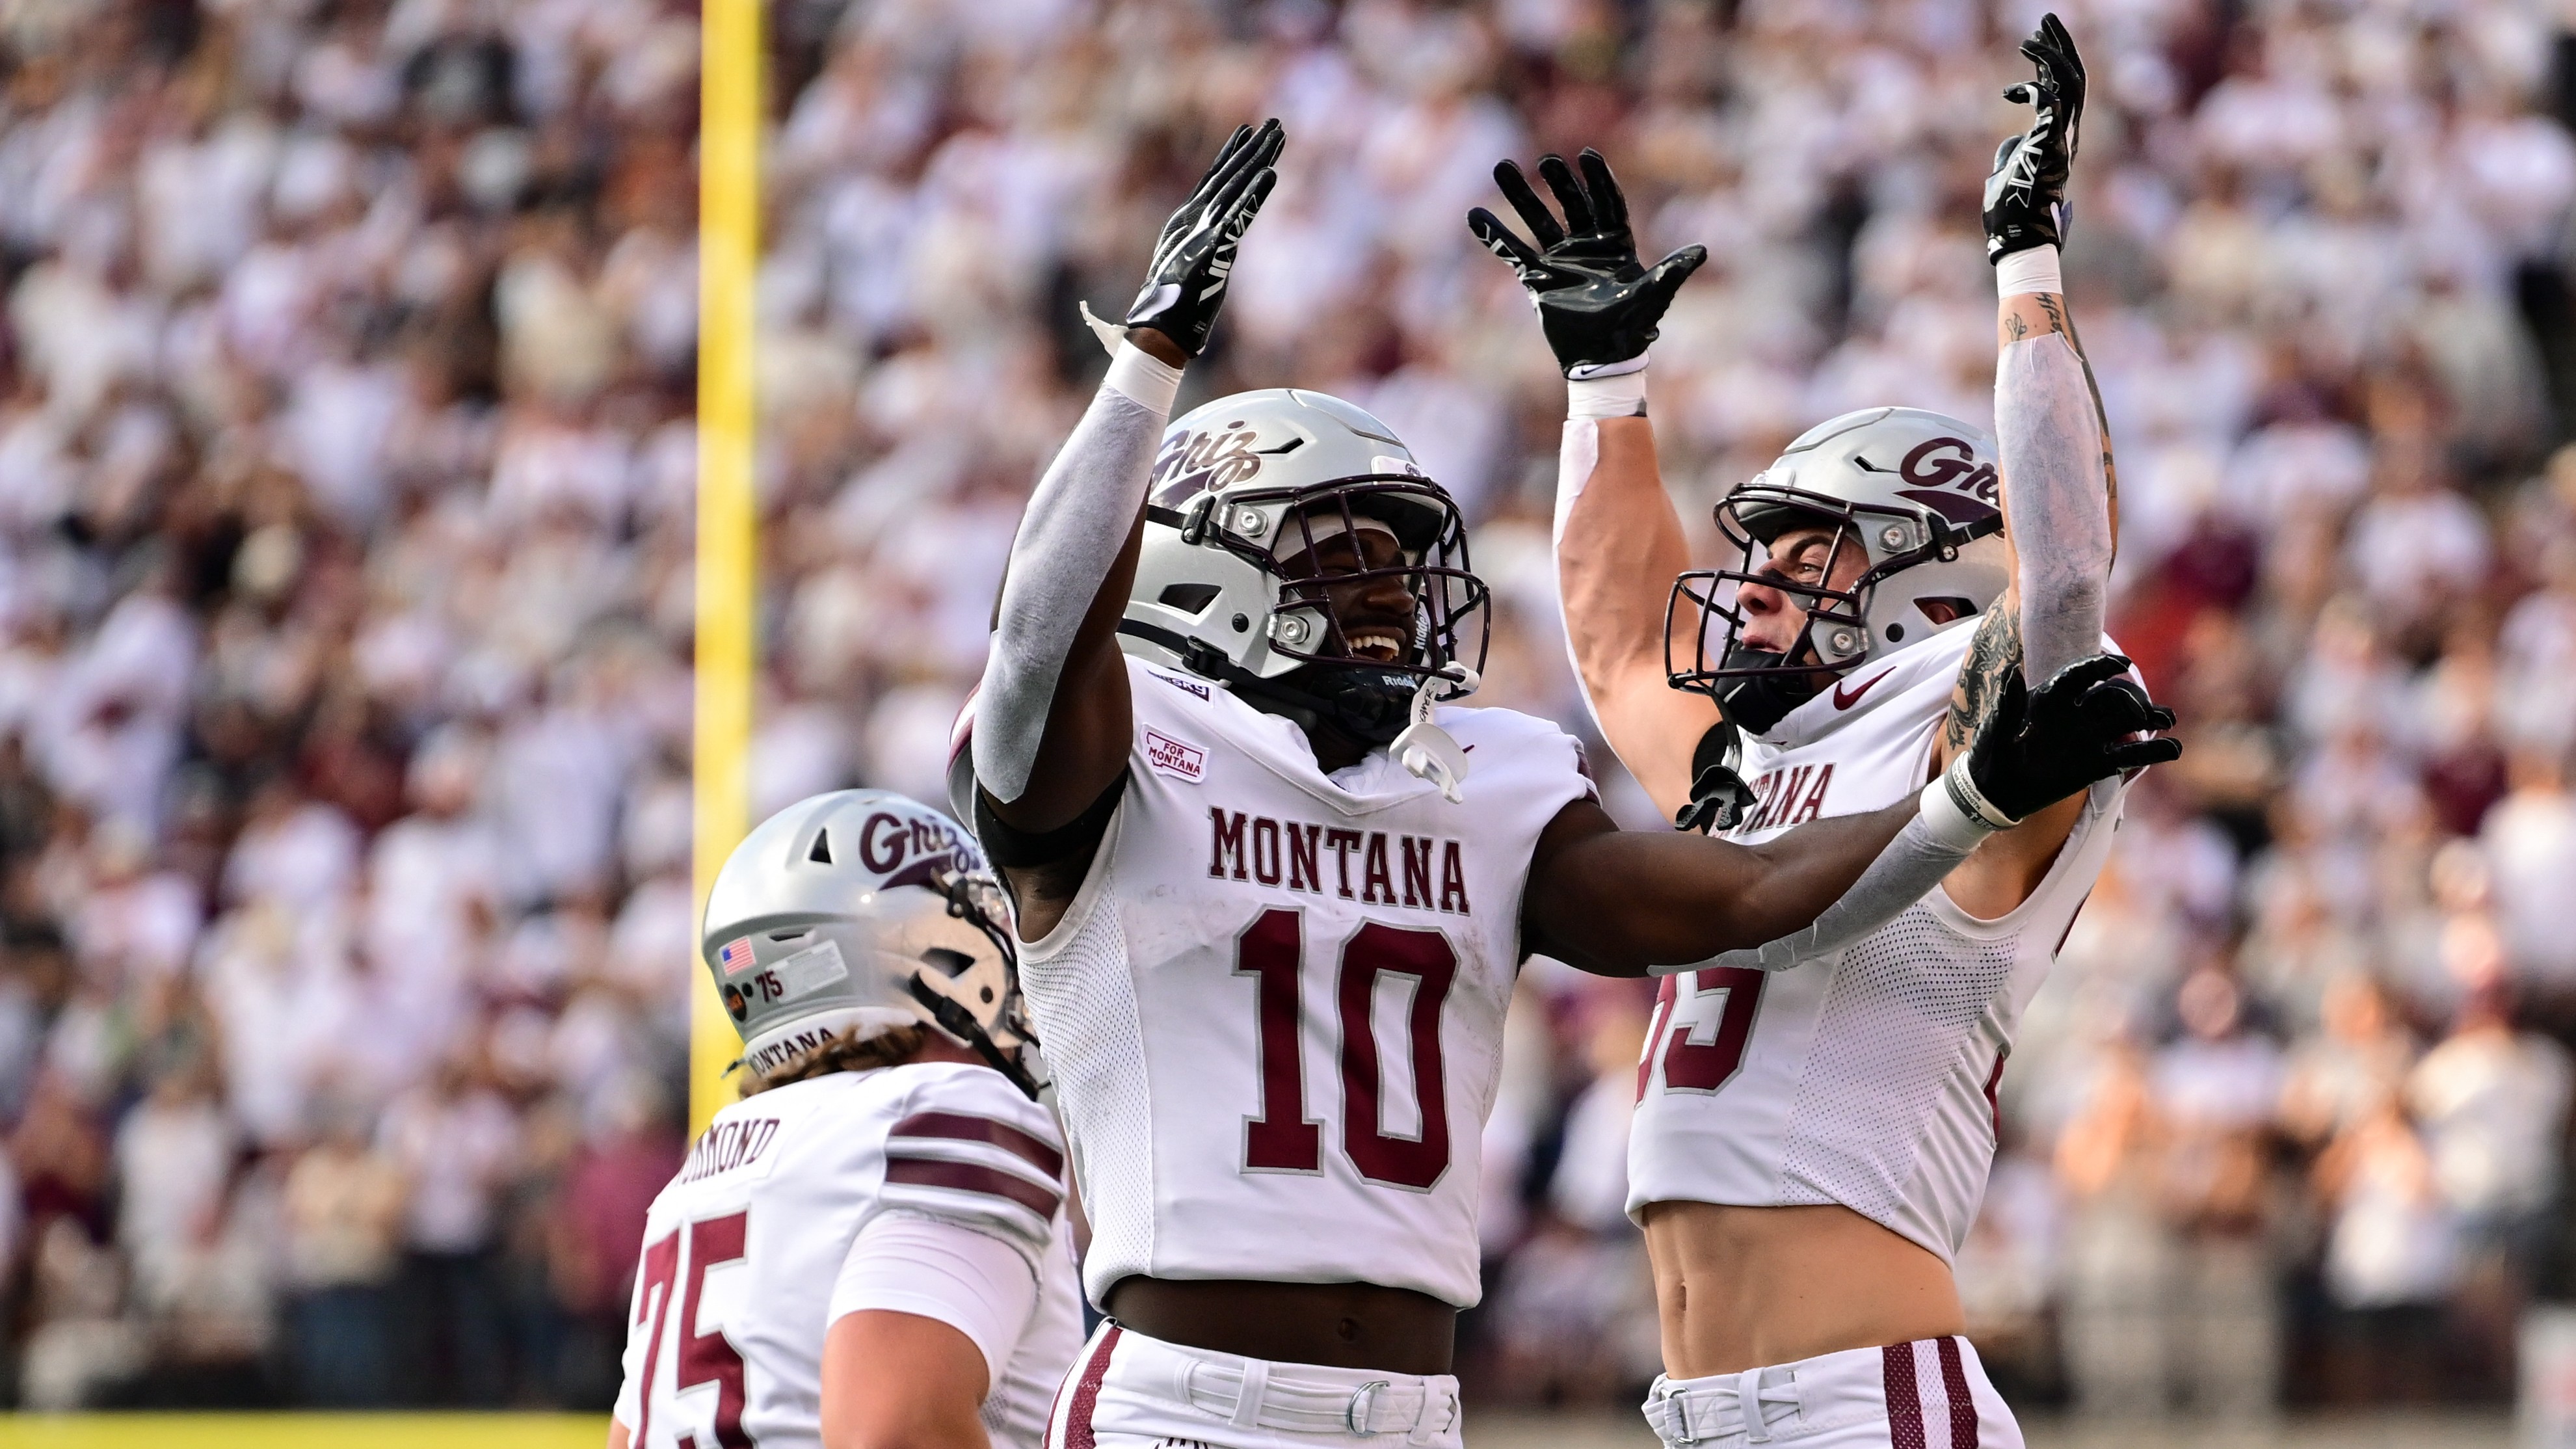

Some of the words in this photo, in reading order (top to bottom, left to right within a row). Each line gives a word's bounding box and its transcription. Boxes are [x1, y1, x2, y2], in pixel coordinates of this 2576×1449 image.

[1900, 436, 2000, 502] Gr
[1148, 747, 1201, 775] MONTANA
[1163, 743, 1184, 758] FOR
[1708, 762, 1837, 838] TANA
[1960, 772, 1982, 802] THROUGH
[860, 812, 981, 874] Griz
[1208, 805, 1470, 916] MONTANA
[754, 970, 784, 1003] 75
[749, 1026, 835, 1078] ONTANA
[1232, 903, 1461, 1195] 10
[1634, 966, 1770, 1110] 5
[633, 1203, 754, 1449] 75
